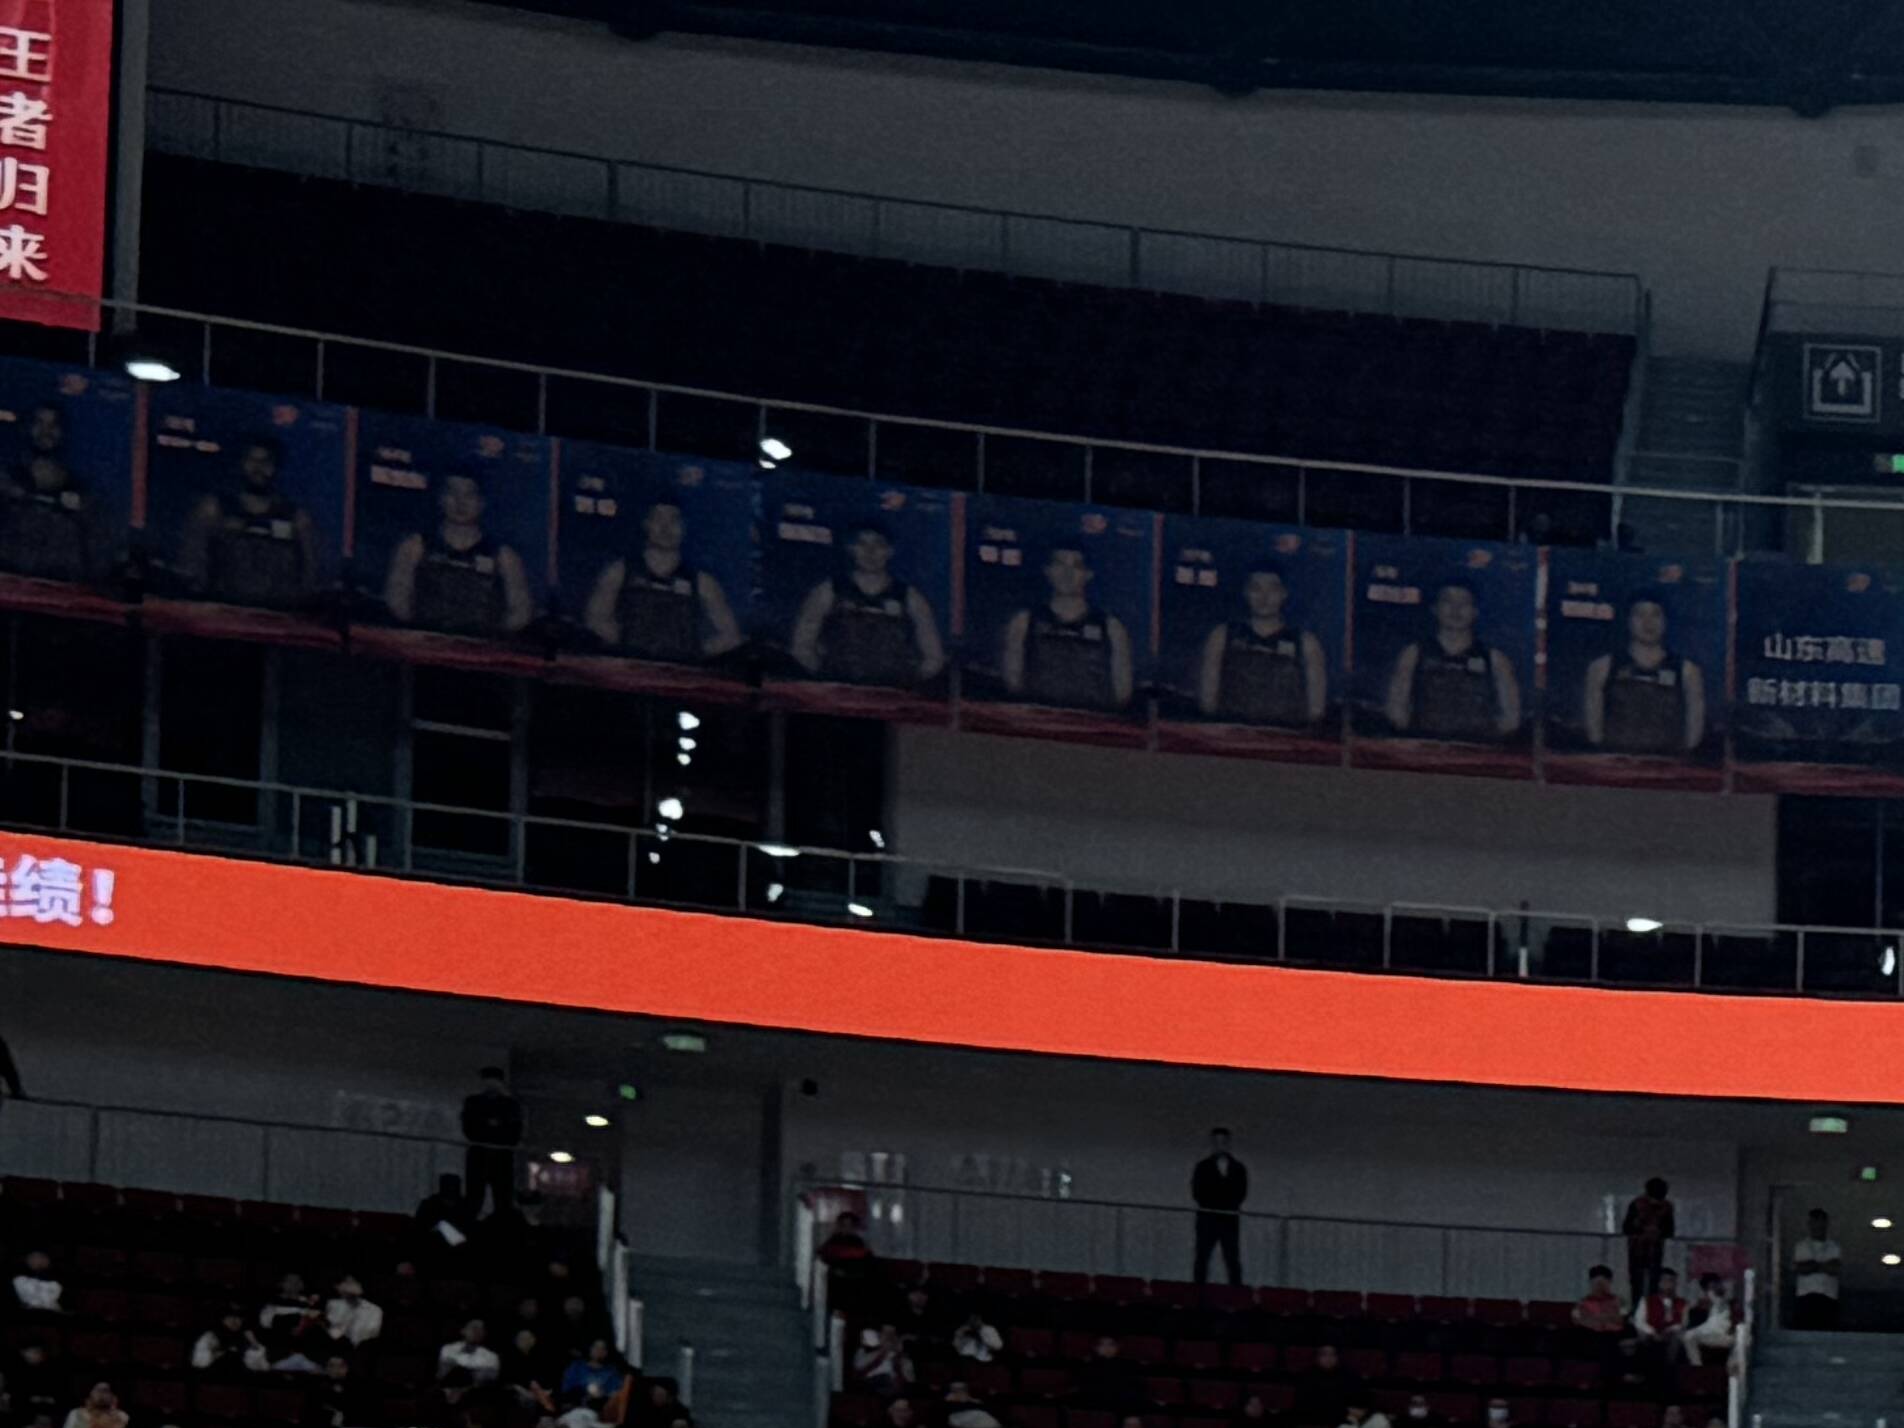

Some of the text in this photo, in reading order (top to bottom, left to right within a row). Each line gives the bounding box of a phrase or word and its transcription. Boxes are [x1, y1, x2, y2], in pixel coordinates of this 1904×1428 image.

[0, 26, 53, 282] 王者归来
[1762, 631, 1887, 666] 山东高速
[0, 853, 115, 927] 绩!
